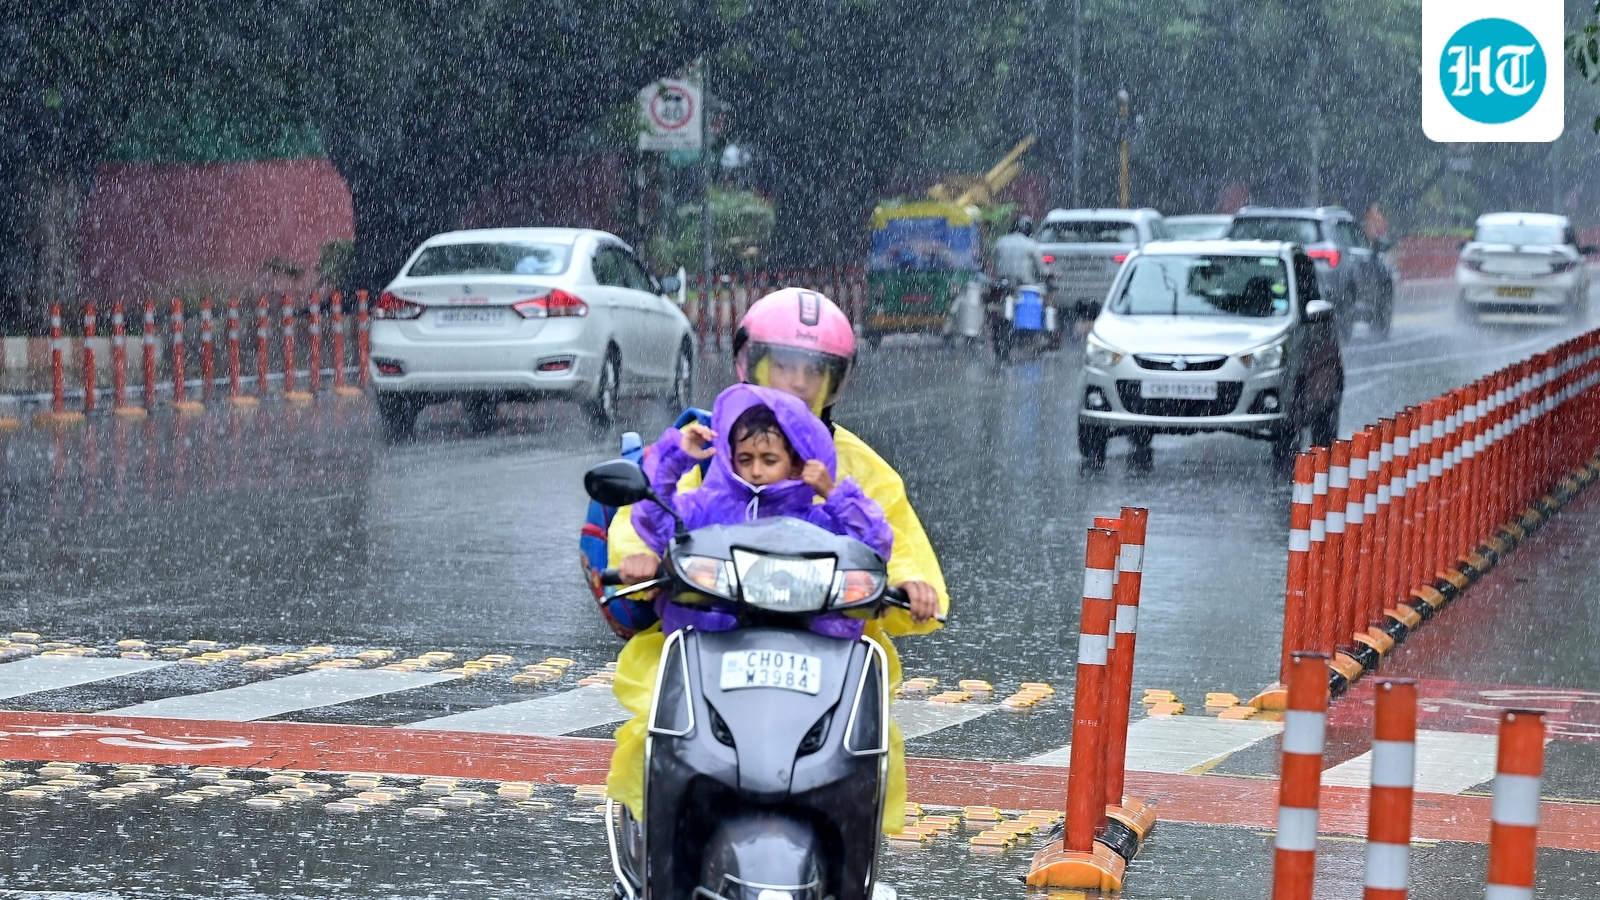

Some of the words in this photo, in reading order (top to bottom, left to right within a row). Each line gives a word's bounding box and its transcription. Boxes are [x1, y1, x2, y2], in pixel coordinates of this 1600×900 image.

[661, 103, 685, 121] 40
[747, 652, 808, 672] CH01A
[746, 669, 808, 688] W3984
